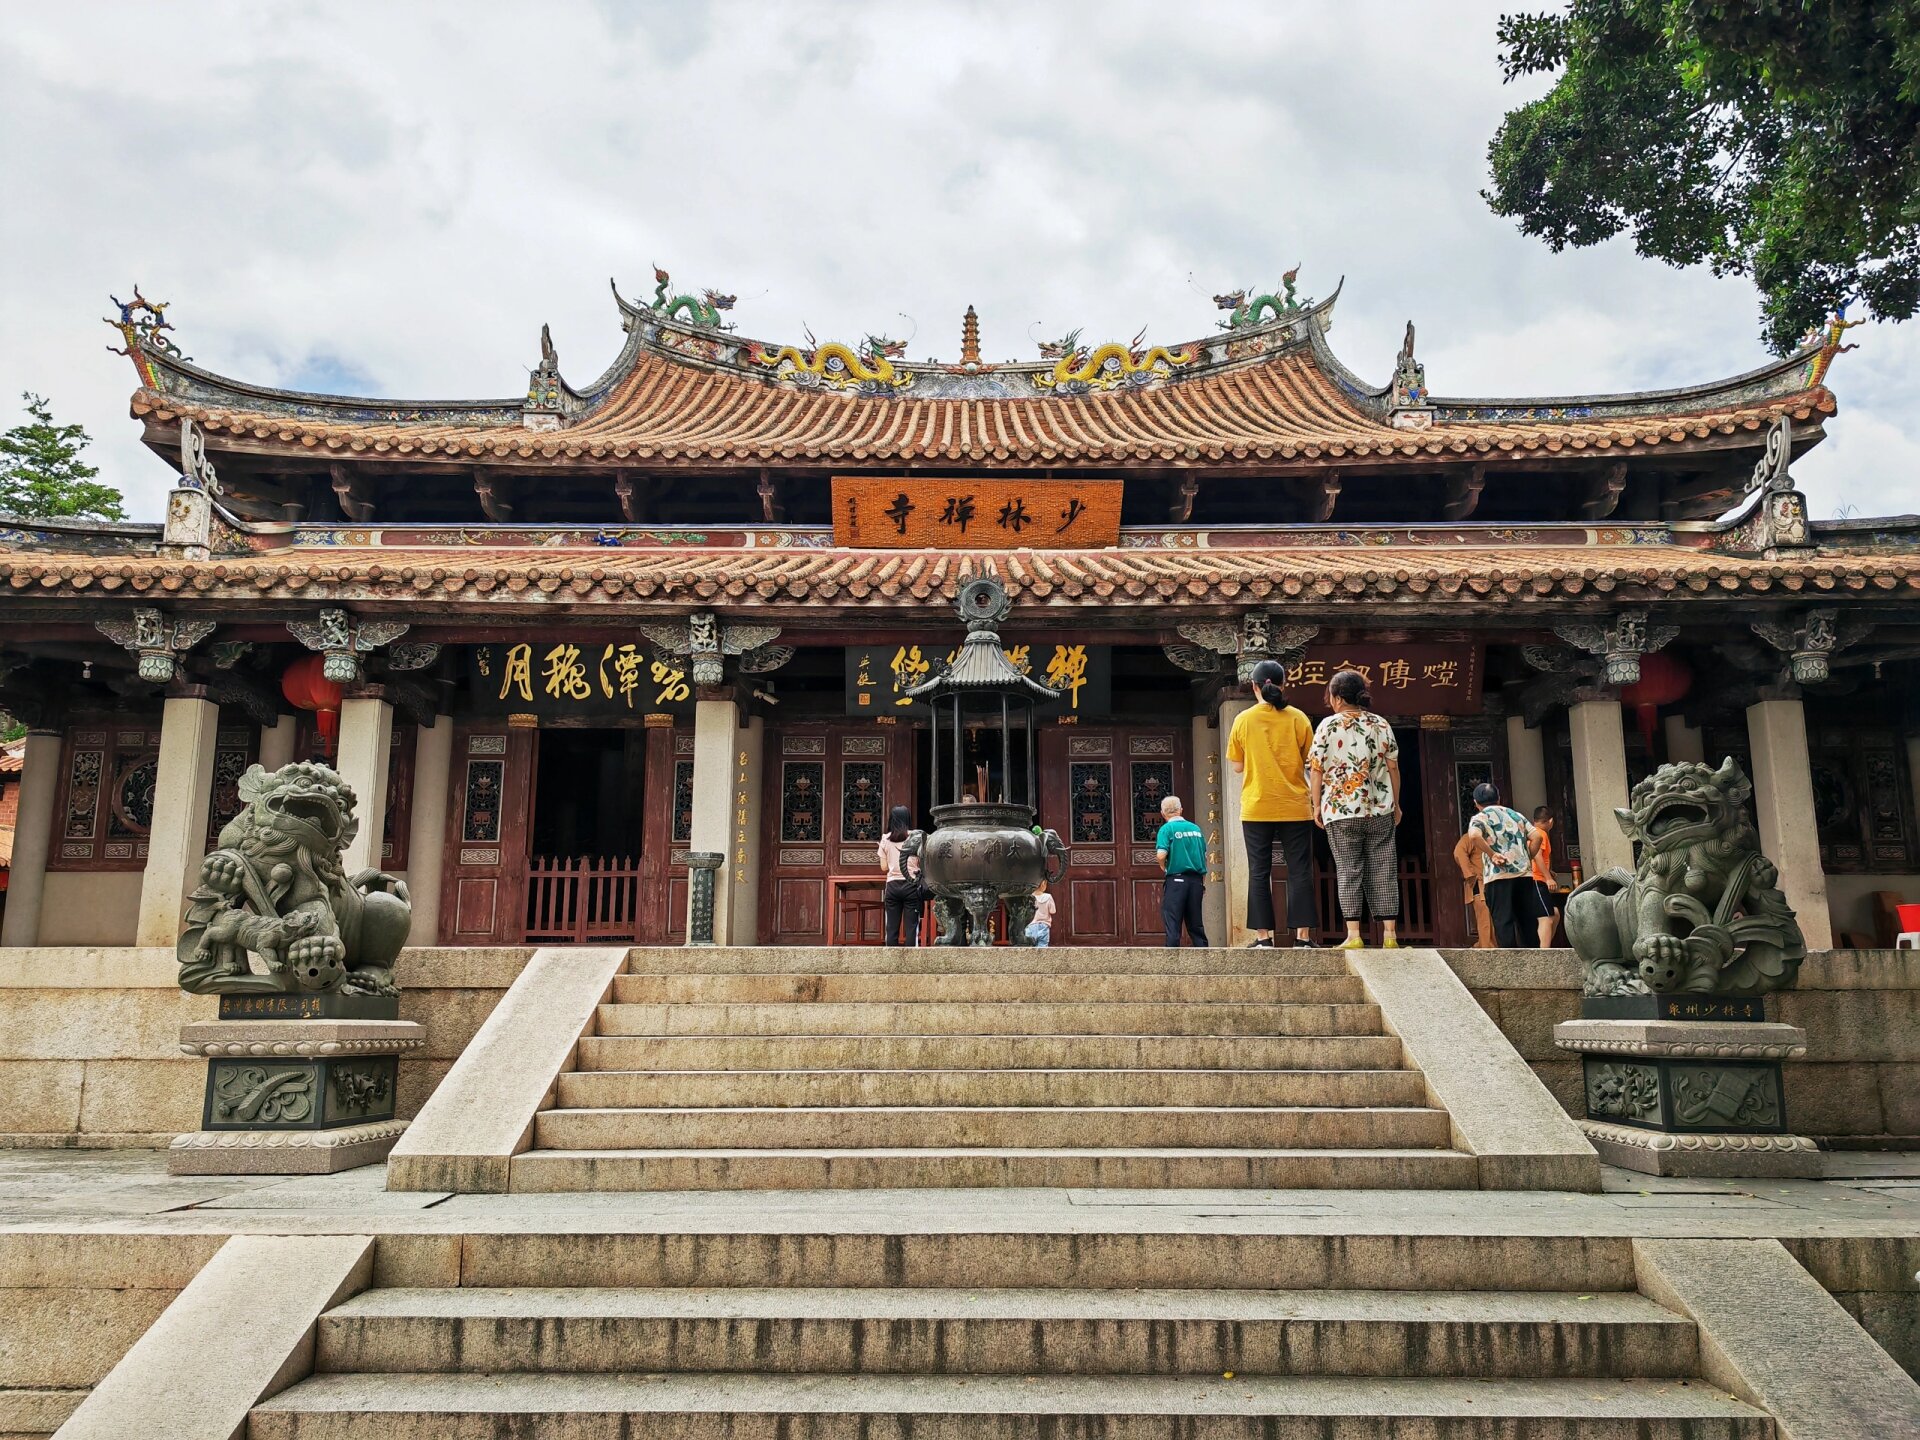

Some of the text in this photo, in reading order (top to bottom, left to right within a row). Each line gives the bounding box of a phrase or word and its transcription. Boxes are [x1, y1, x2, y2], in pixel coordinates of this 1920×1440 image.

[1668, 1003, 1753, 1016] 泉州少林寺
